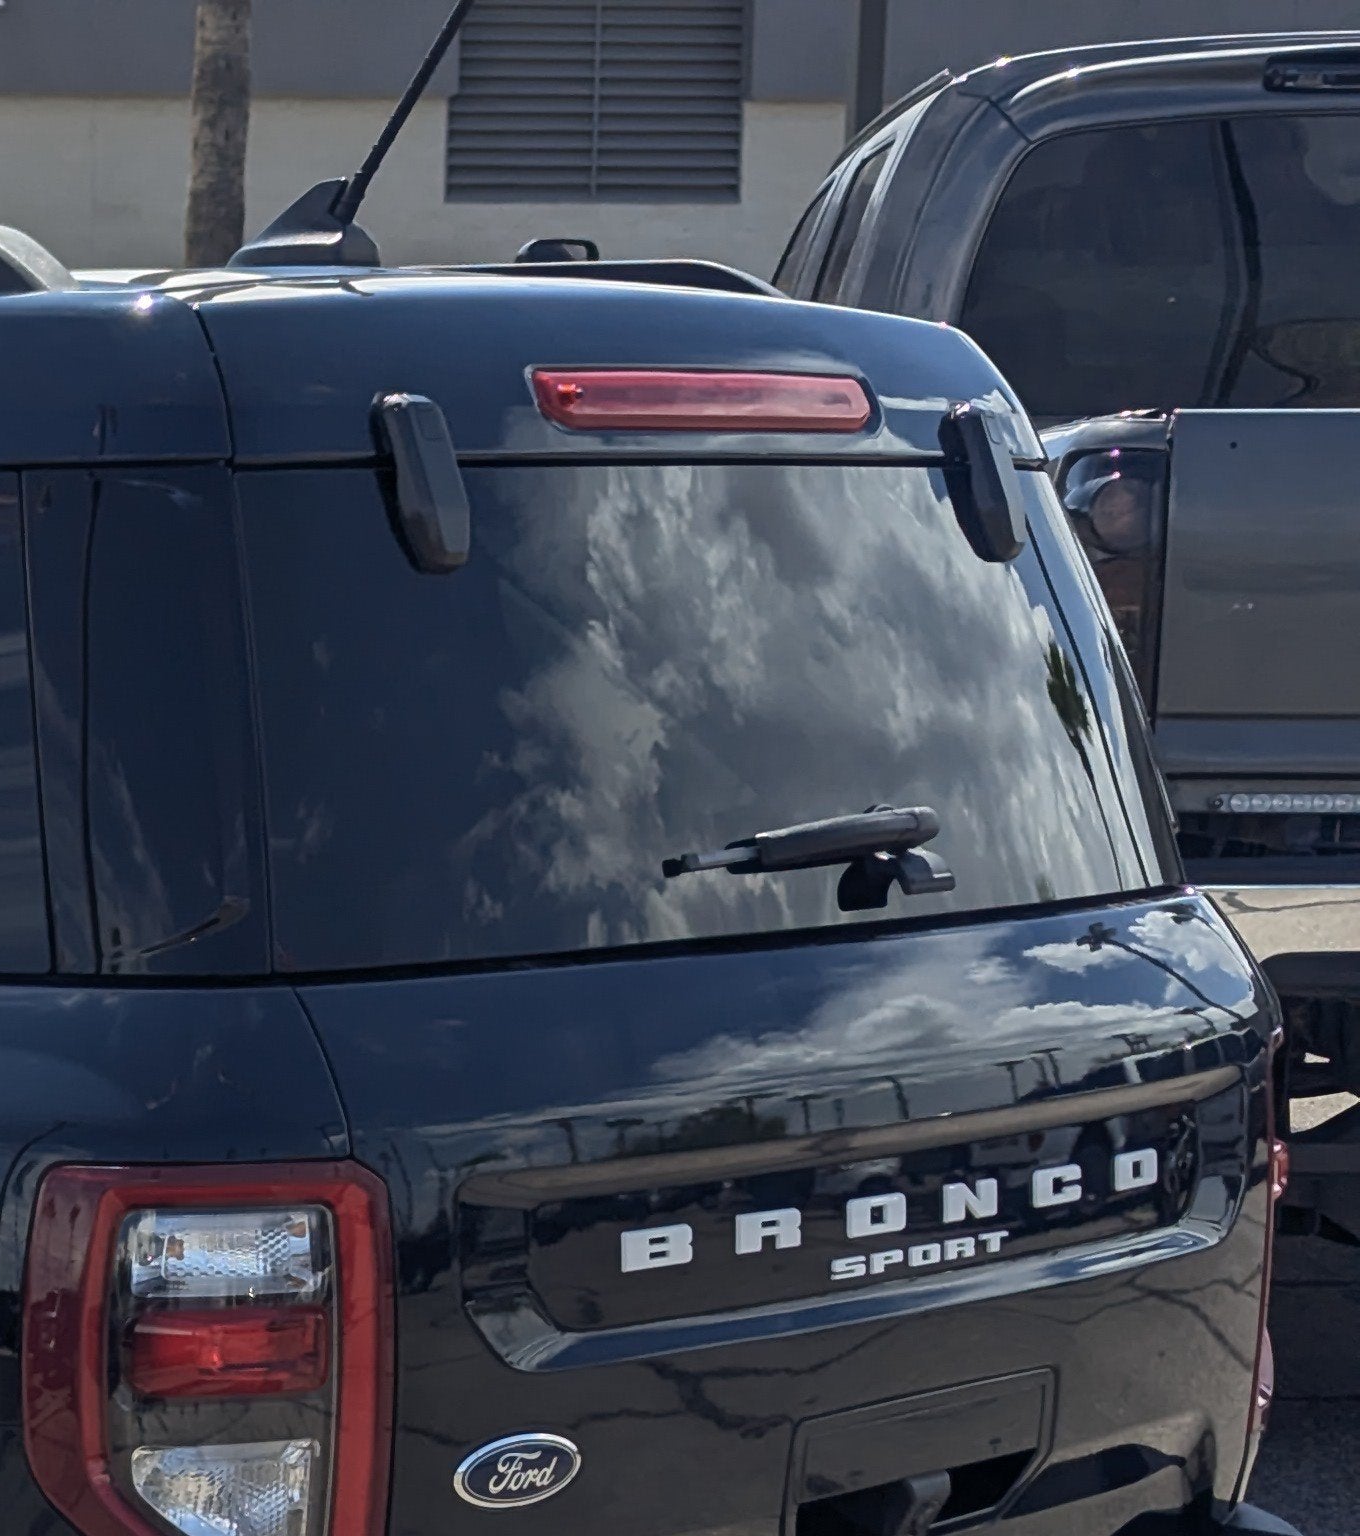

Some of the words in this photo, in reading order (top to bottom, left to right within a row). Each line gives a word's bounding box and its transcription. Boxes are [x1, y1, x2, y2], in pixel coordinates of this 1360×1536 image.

[620, 1148, 1158, 1273] BRONCO
[830, 1230, 1009, 1280] SPORT
[488, 1450, 558, 1494] Ford
